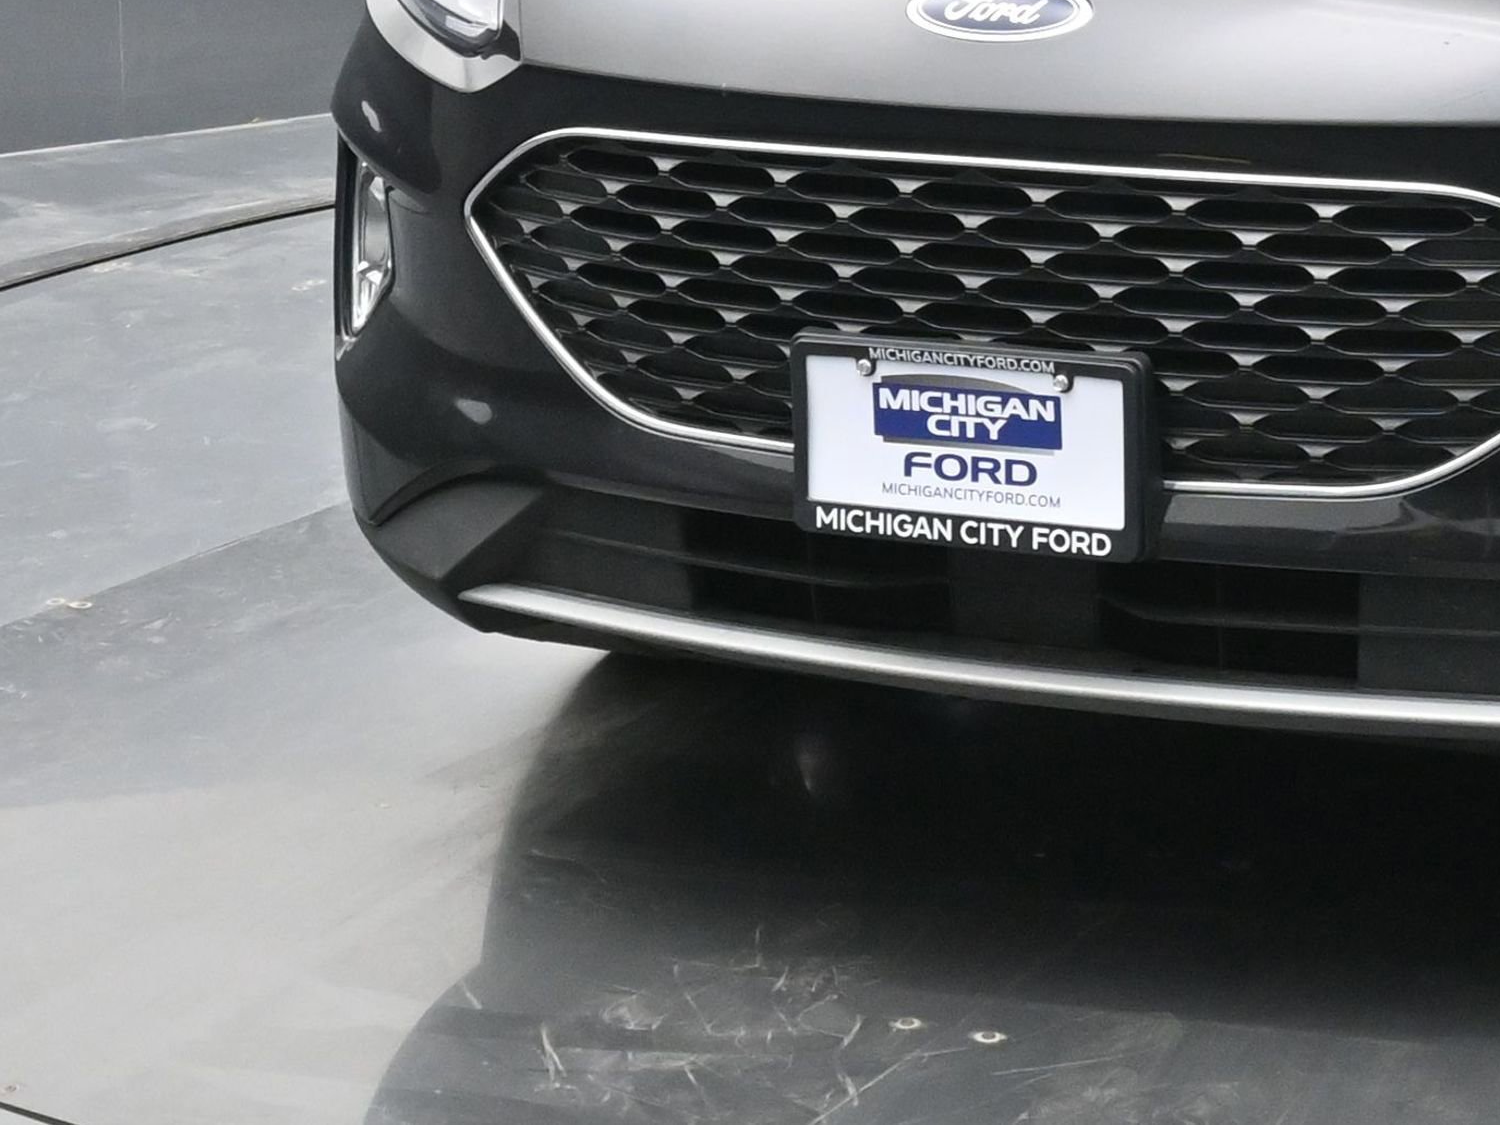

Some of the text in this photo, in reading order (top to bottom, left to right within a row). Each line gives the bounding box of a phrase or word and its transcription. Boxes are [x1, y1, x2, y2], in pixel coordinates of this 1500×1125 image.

[869, 347, 1055, 374] MICHIGANCITYFORD.COM
[878, 387, 1055, 422] MICHIGAN
[926, 414, 1007, 441] CITY
[904, 451, 1038, 487] FORD
[882, 482, 1061, 508] MICHIGANCITYFORD.COM
[815, 506, 1112, 557] MICHIGAN CITY FORD
